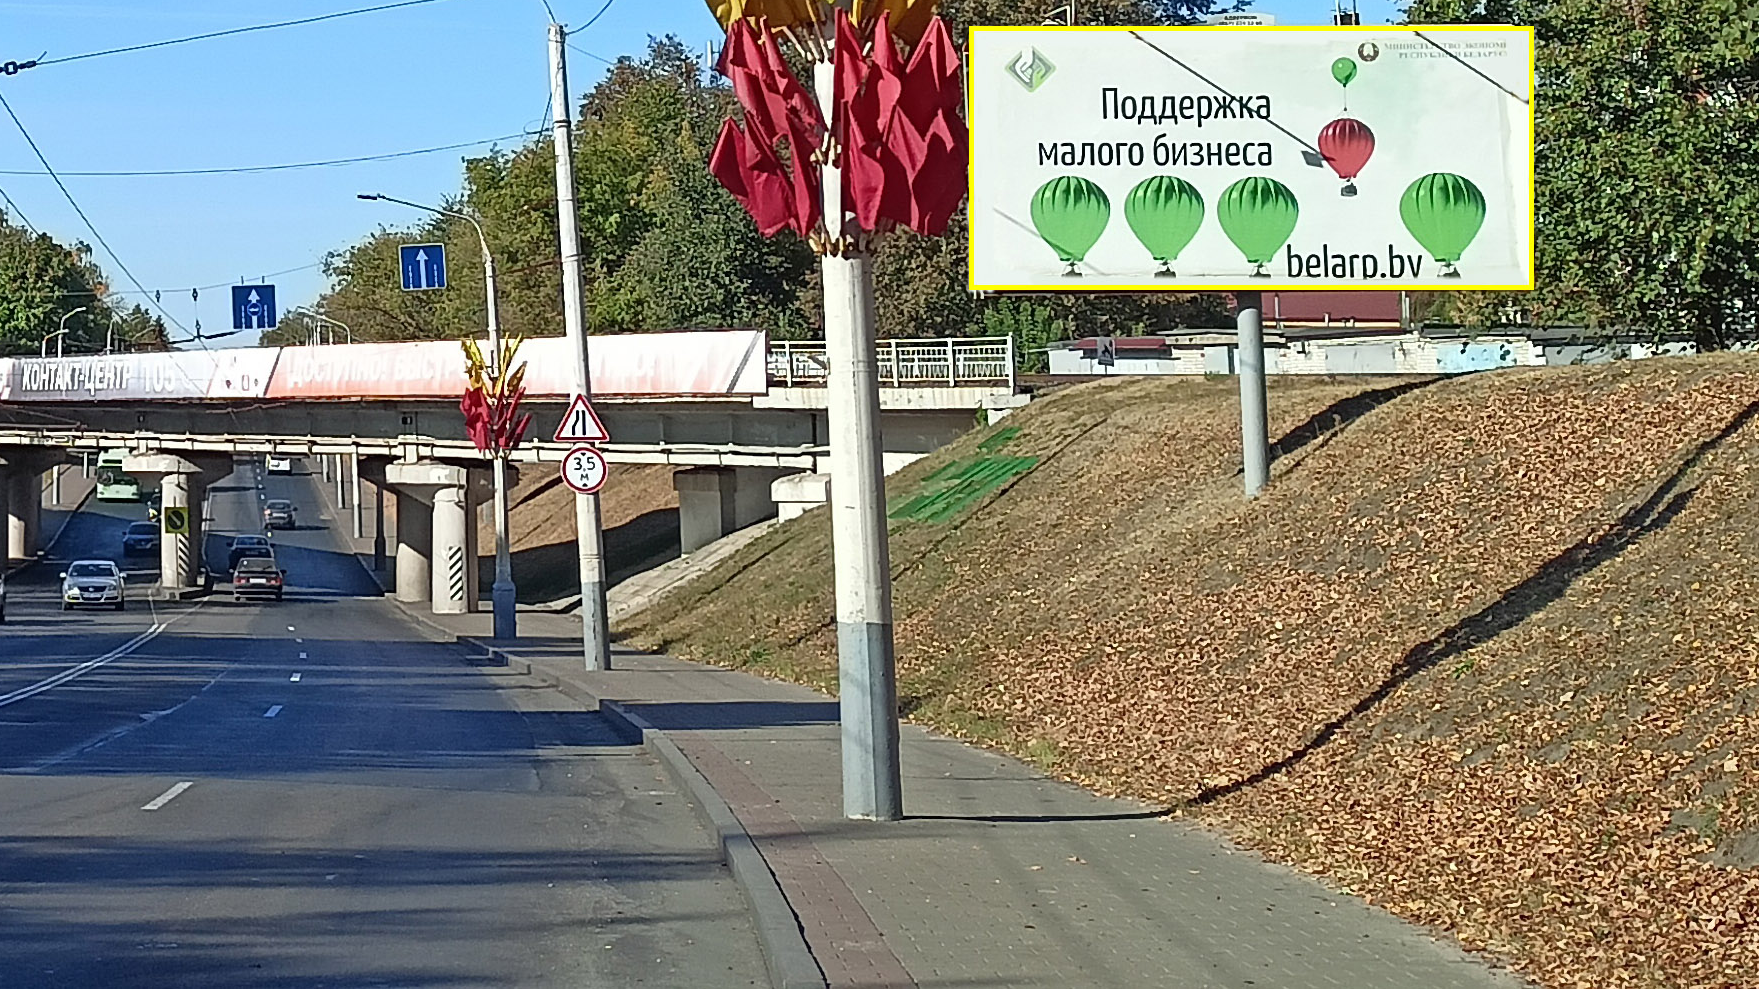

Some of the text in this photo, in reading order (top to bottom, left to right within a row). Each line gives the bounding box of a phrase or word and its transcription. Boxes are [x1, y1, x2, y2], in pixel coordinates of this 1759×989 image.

[1101, 87, 1271, 128] Поддержка
[1038, 132, 1273, 167] малого бизнеса
[21, 361, 131, 397] КОНТАКТ-ЦЕНТР
